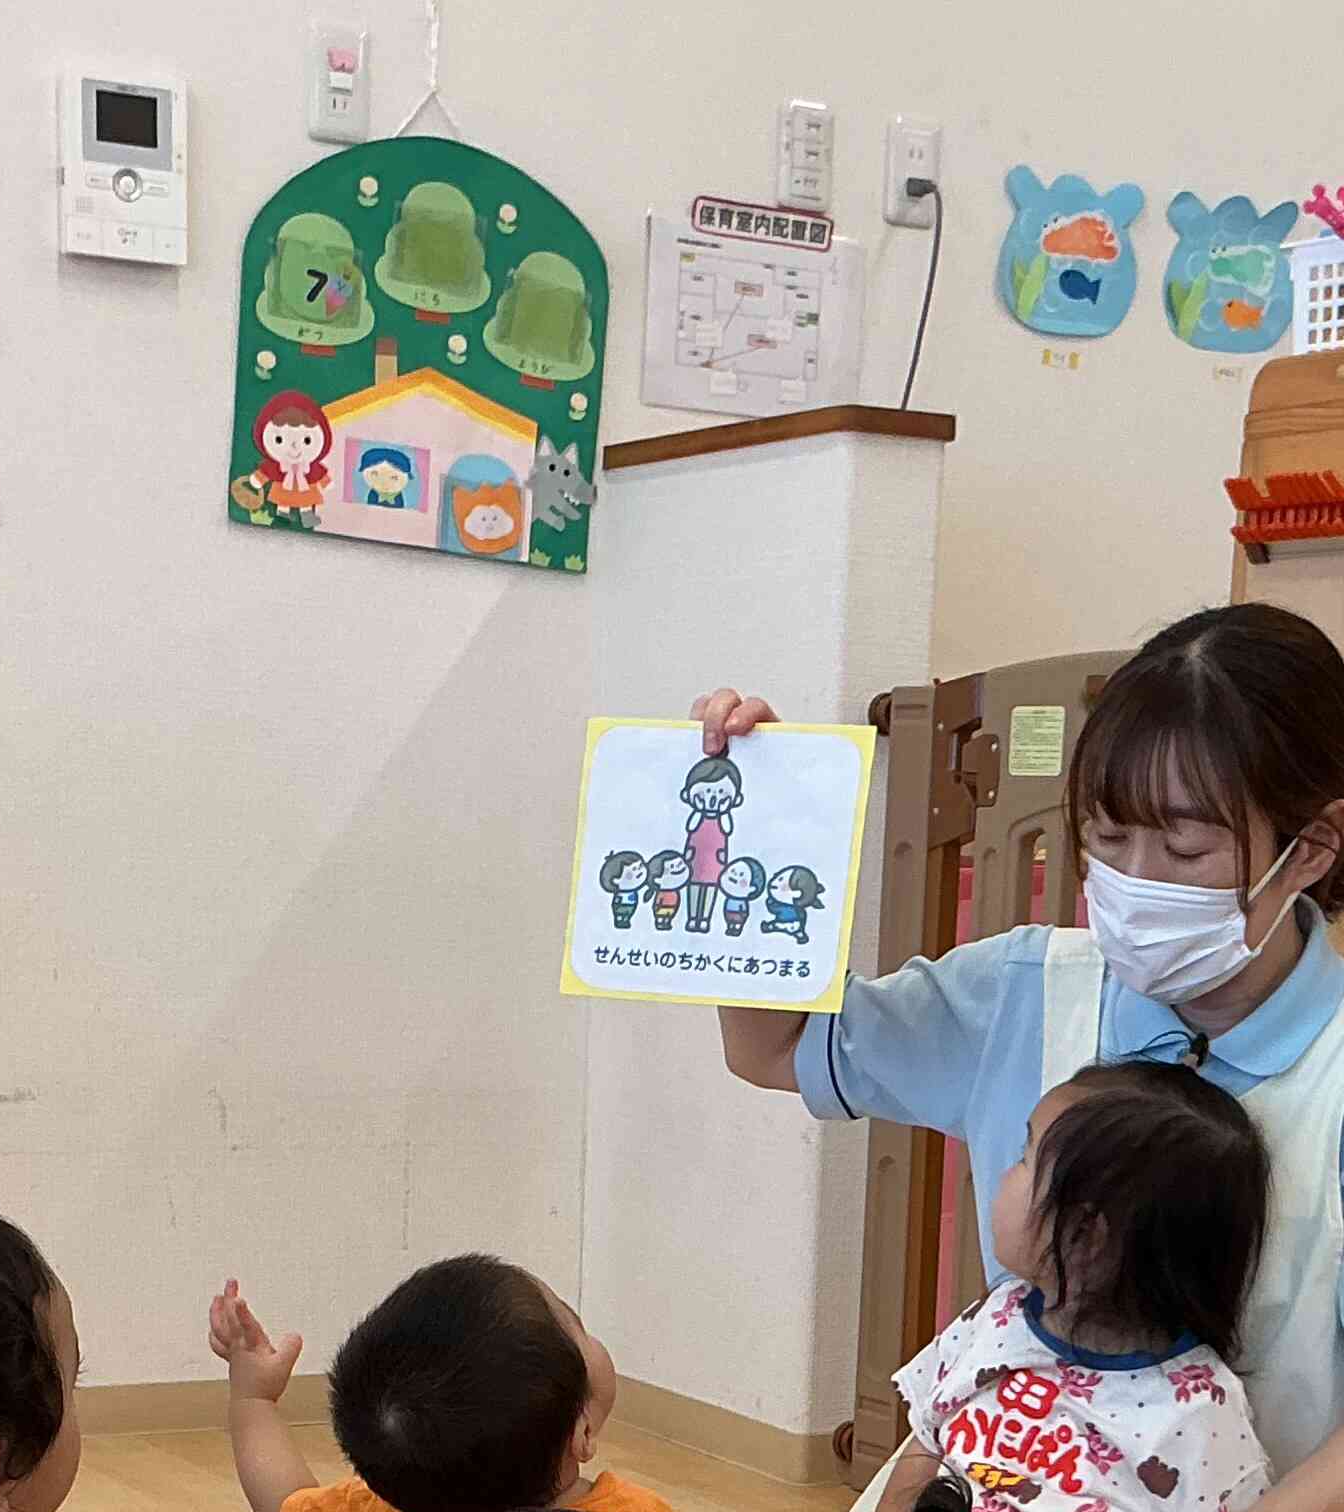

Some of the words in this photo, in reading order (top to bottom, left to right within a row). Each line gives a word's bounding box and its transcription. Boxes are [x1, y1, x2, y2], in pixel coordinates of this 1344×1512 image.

[699, 206, 827, 244] 保育室内配置図
[306, 269, 328, 302] 7
[593, 946, 811, 978] せんせいのちかくにあつまる
